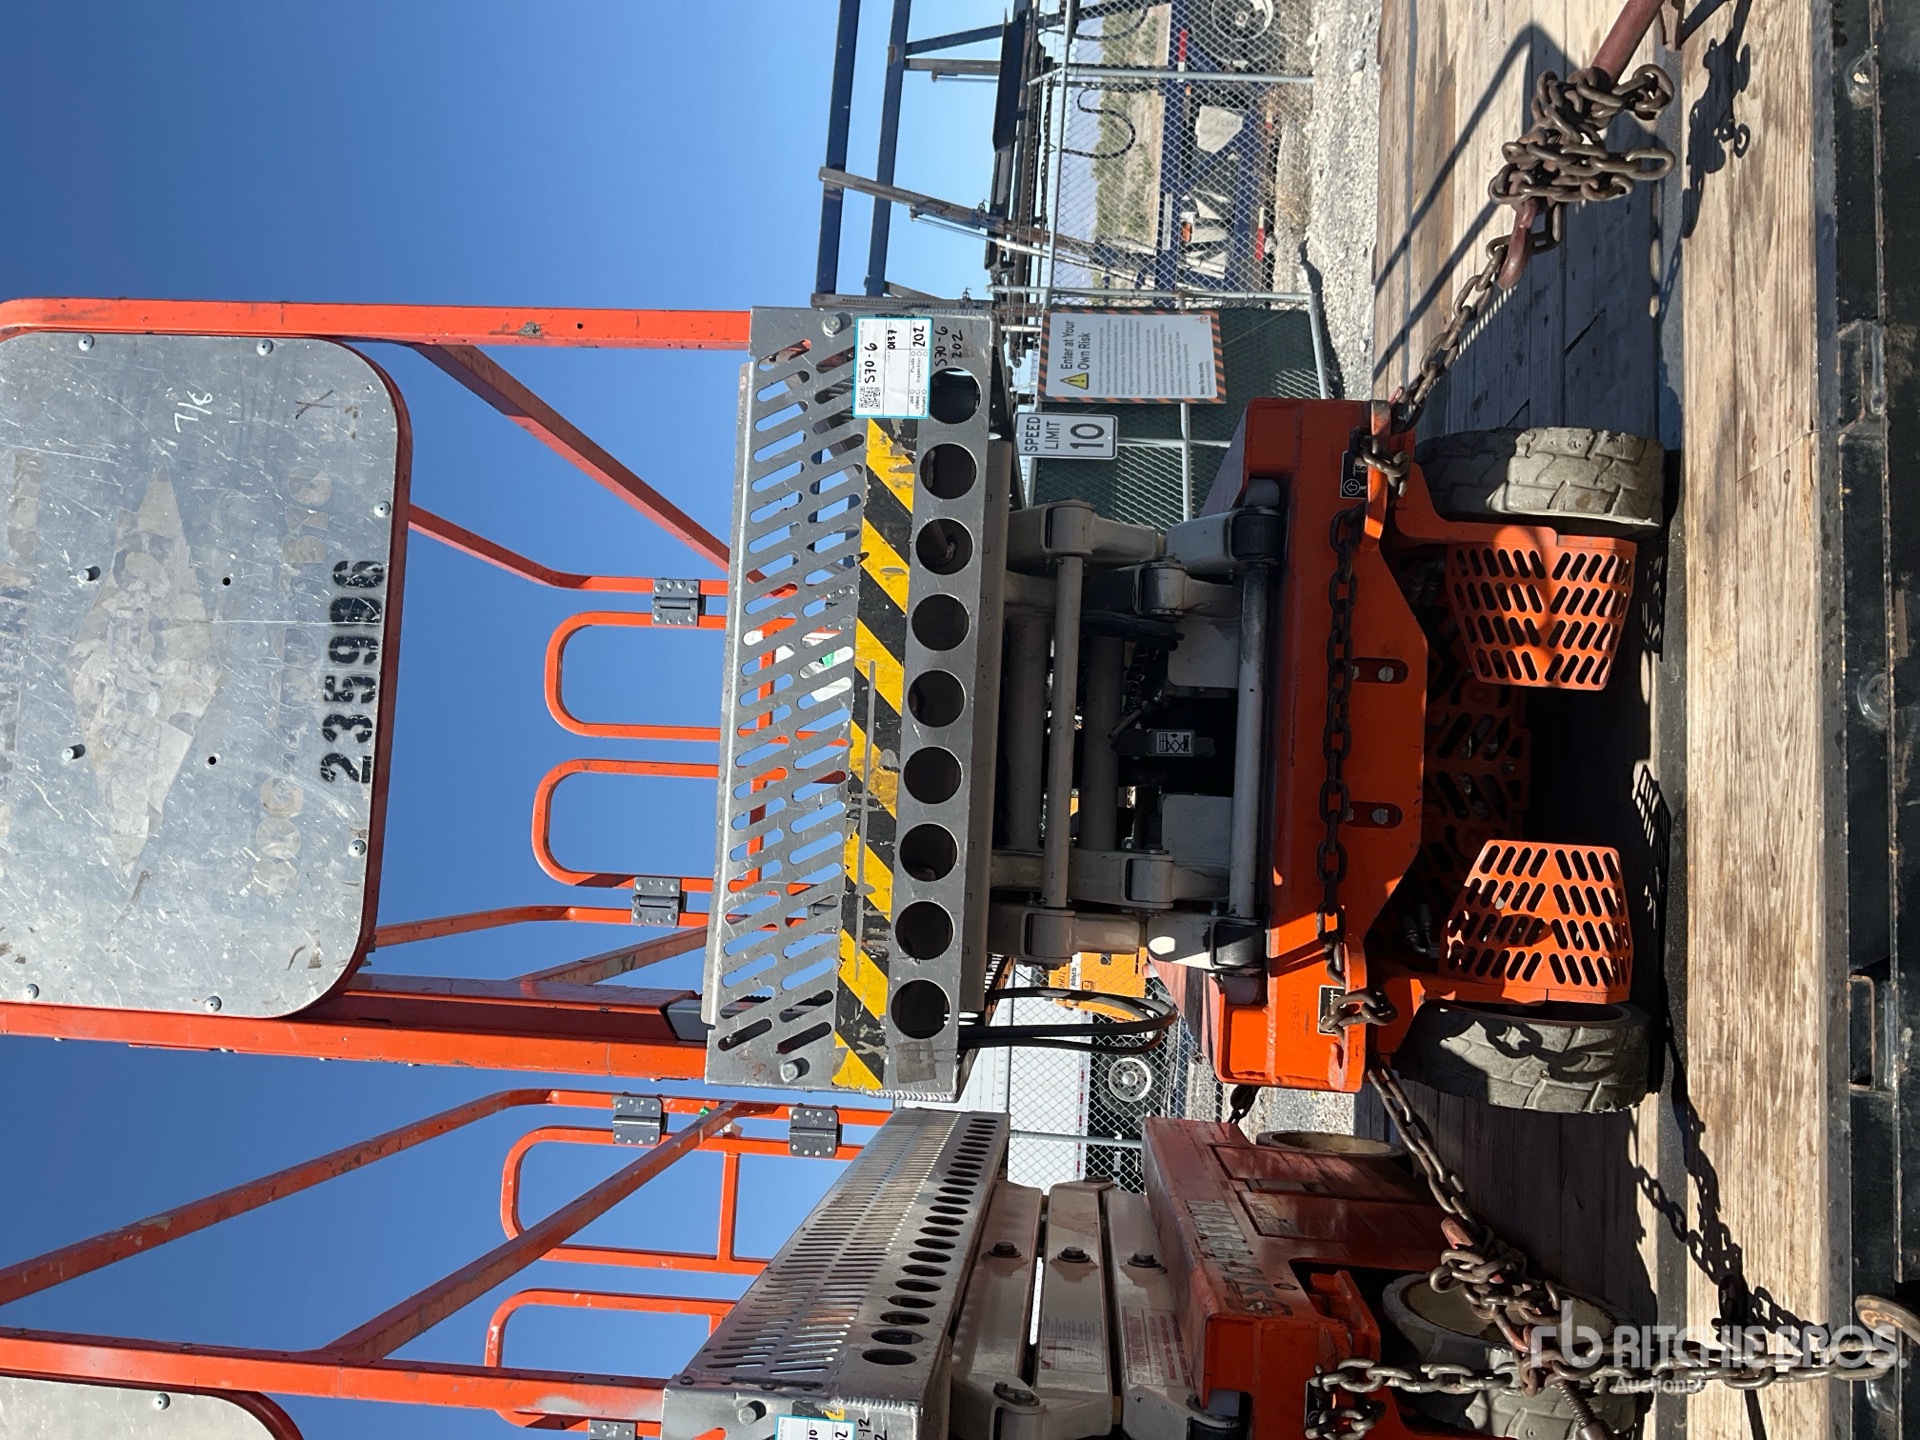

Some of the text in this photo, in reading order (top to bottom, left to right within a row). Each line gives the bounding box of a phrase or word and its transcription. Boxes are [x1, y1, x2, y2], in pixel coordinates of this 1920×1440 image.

[887, 329, 897, 350] 0137
[912, 325, 926, 347] 202
[934, 326, 949, 367] S70-6
[951, 329, 963, 359] 202
[1060, 320, 1075, 369] Enter at Your
[1077, 332, 1090, 370] Own Risk
[864, 342, 878, 384] S70-6
[1024, 416, 1041, 452] SPEED
[1044, 421, 1060, 449] LIMIT
[1069, 423, 1104, 450] 10
